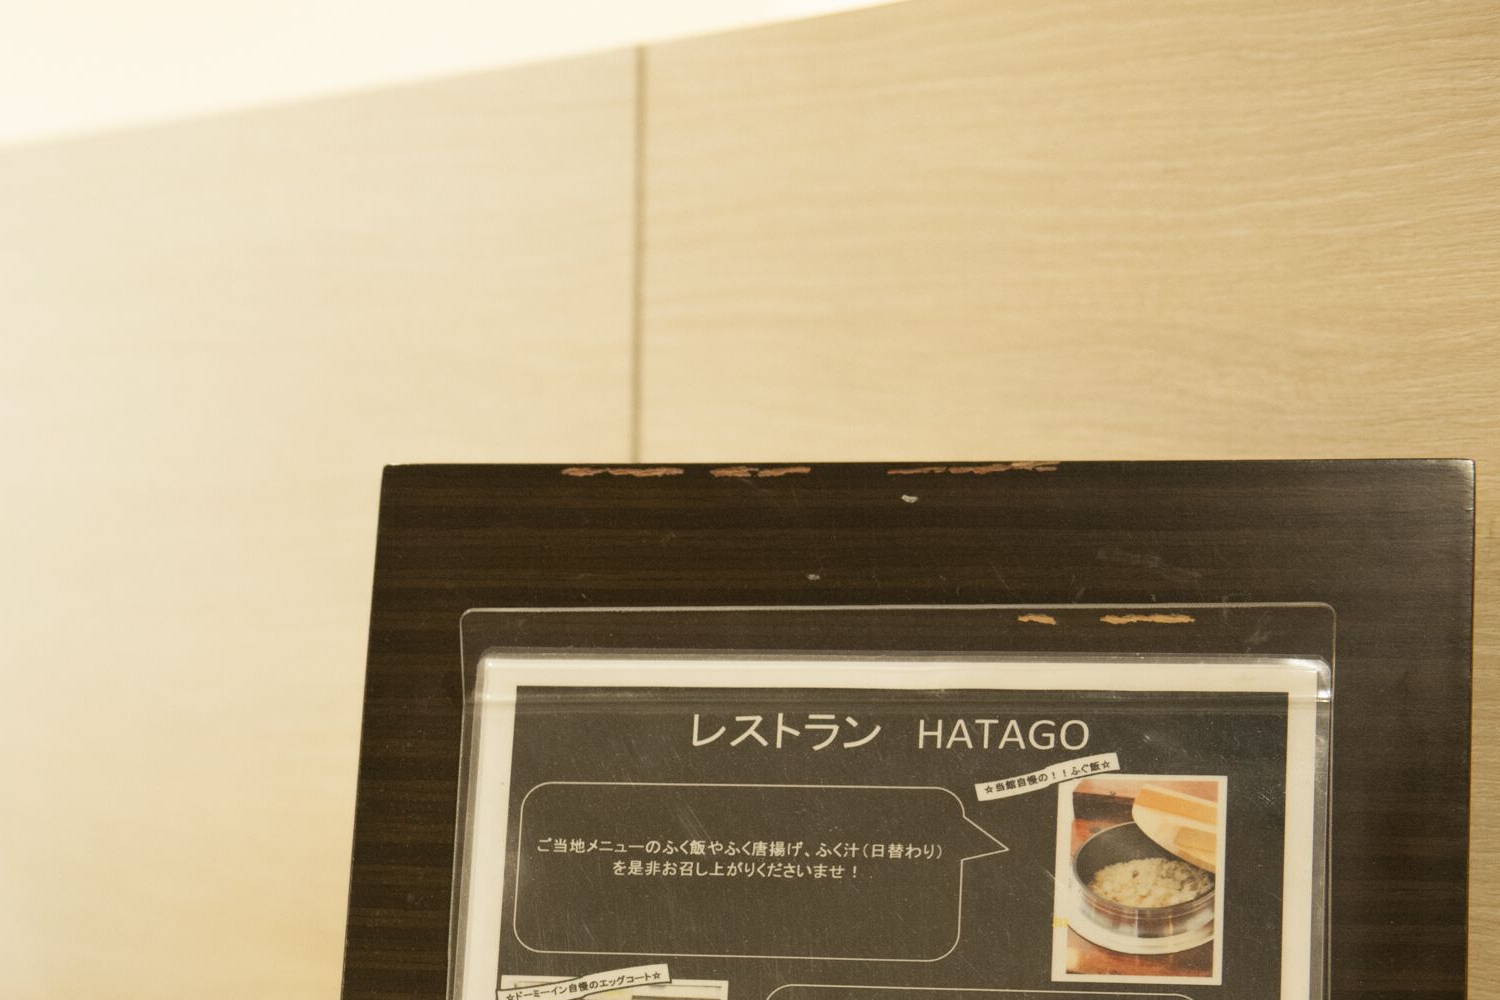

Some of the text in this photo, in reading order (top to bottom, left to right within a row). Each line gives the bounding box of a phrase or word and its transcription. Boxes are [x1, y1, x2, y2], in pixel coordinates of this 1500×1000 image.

[690, 711, 1091, 751] レストラン HATAGO
